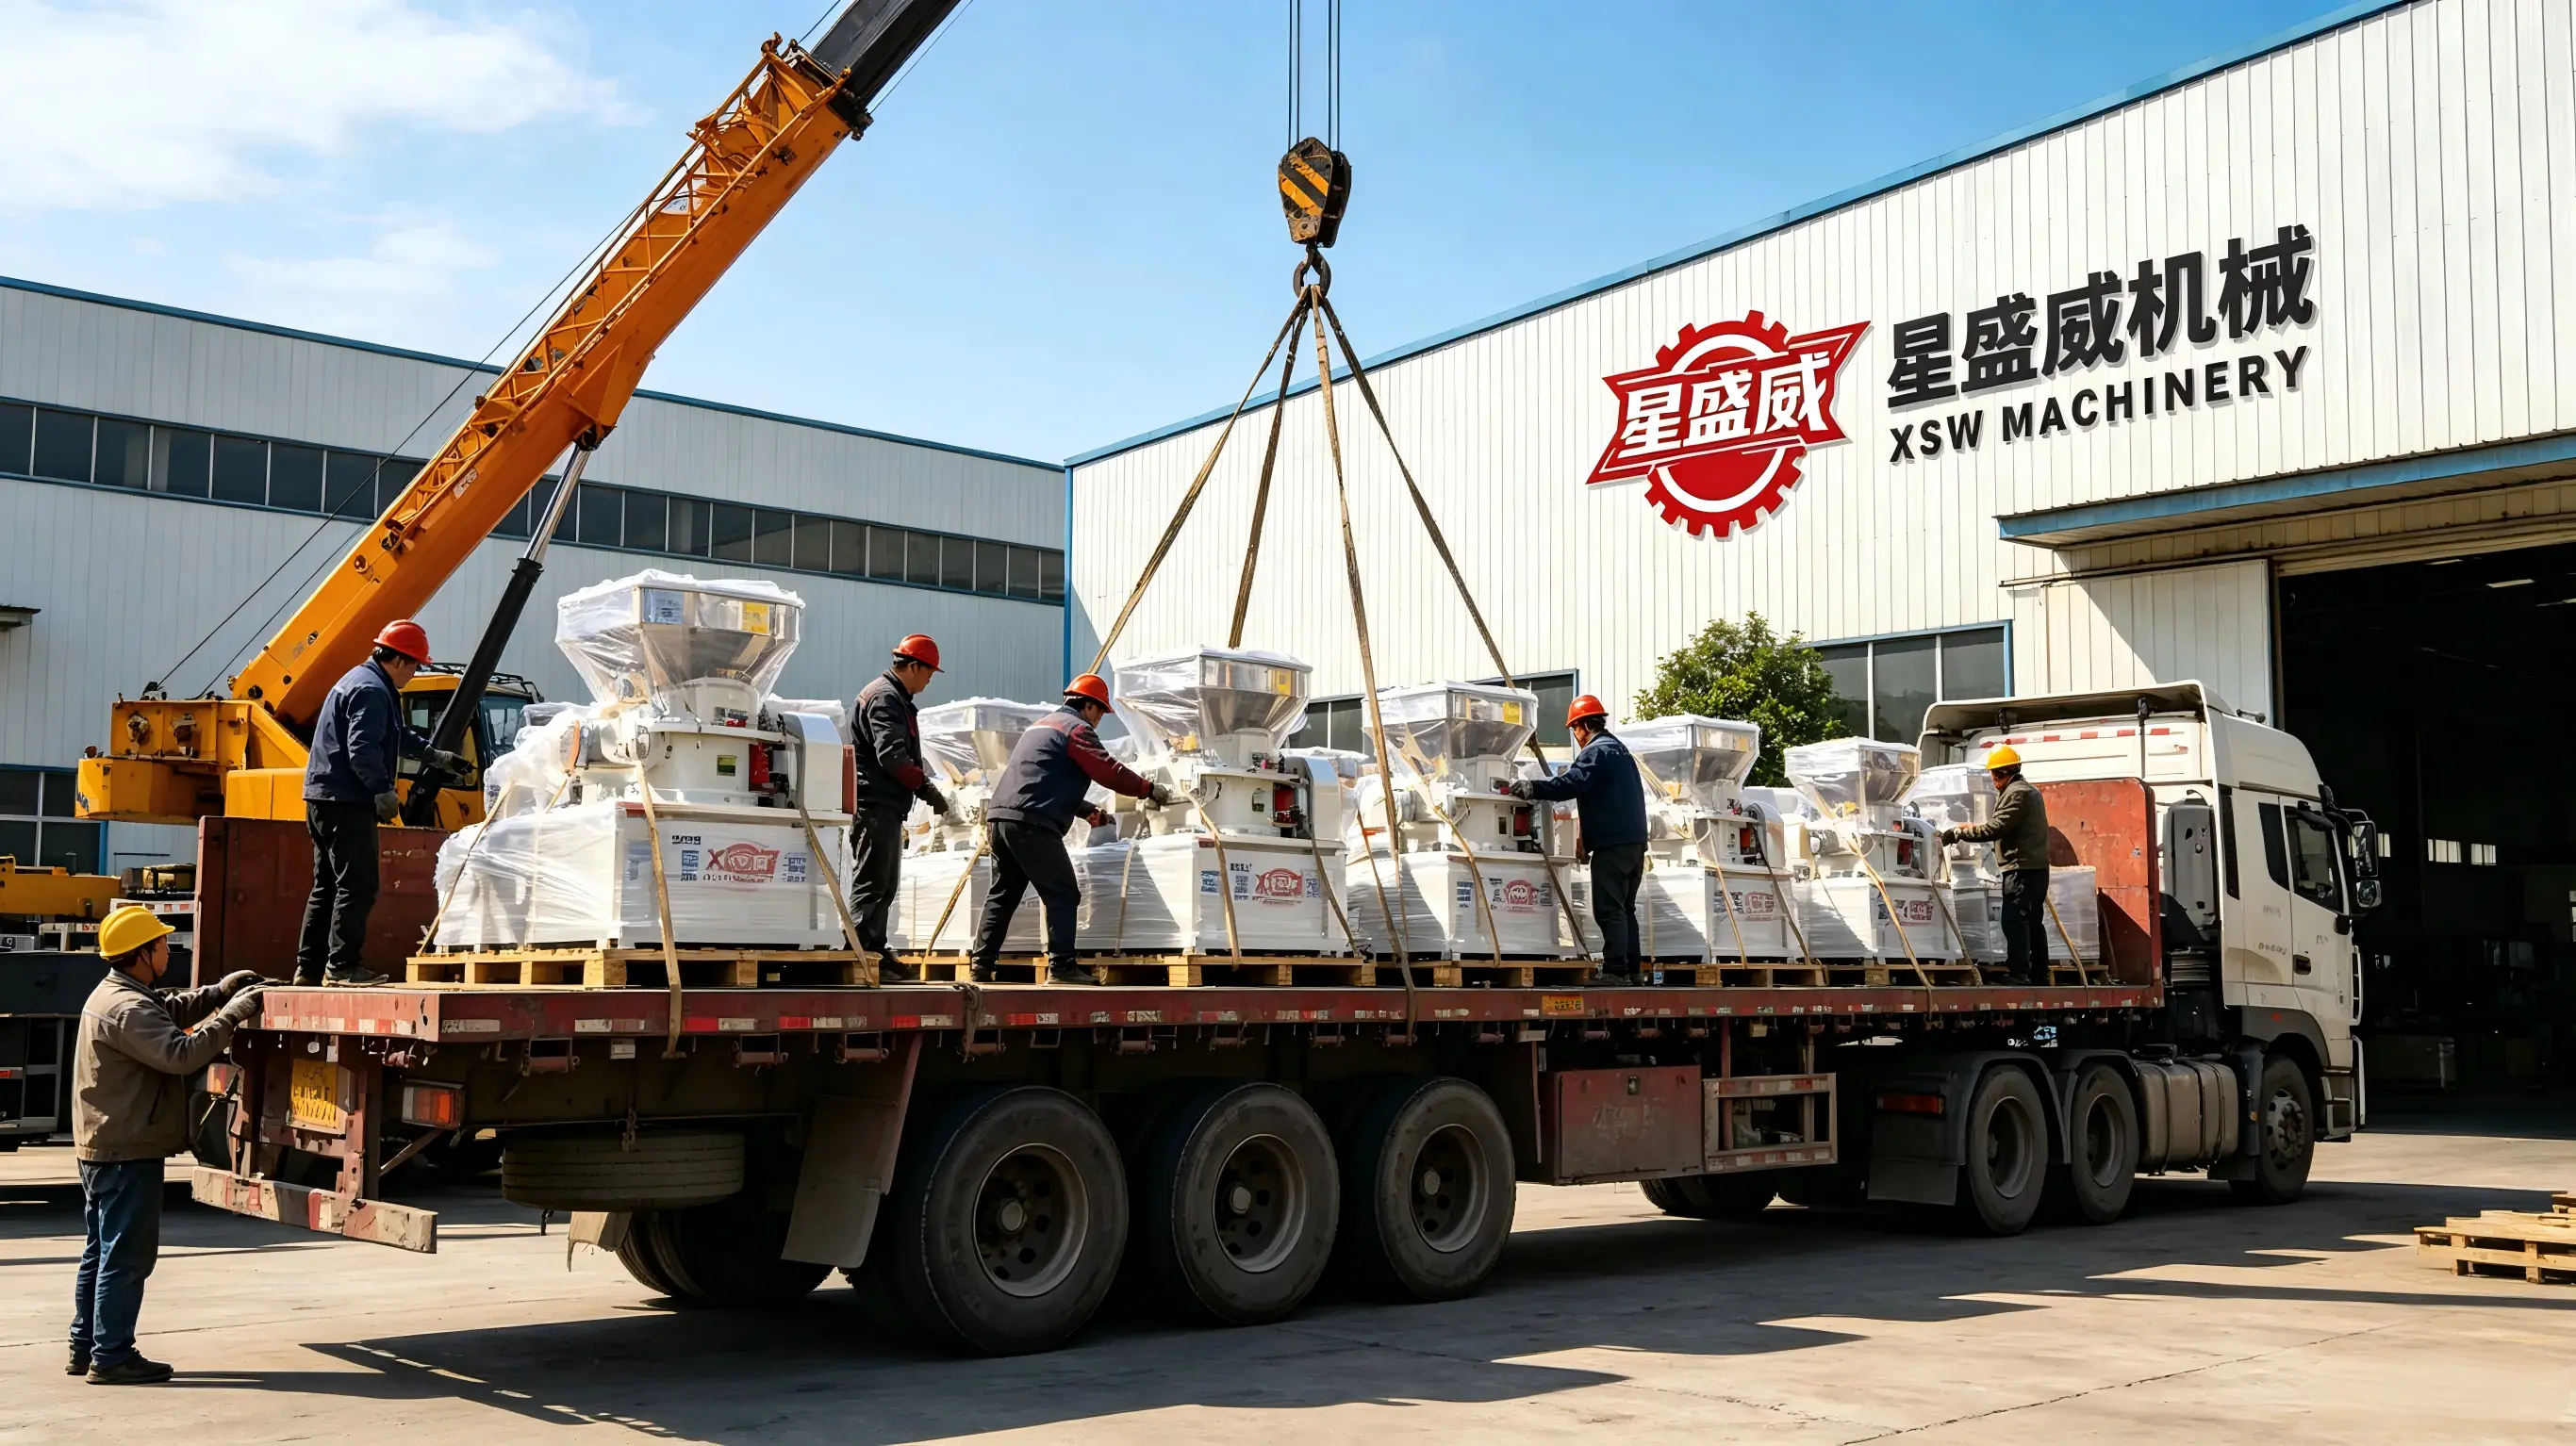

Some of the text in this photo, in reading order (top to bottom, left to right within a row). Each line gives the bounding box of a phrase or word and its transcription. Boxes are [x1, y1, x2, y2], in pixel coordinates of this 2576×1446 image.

[1887, 223, 2315, 408] 星盛威机械
[1616, 351, 1831, 460] 星盛威
[1890, 346, 2308, 463] XSW MACHINERY
